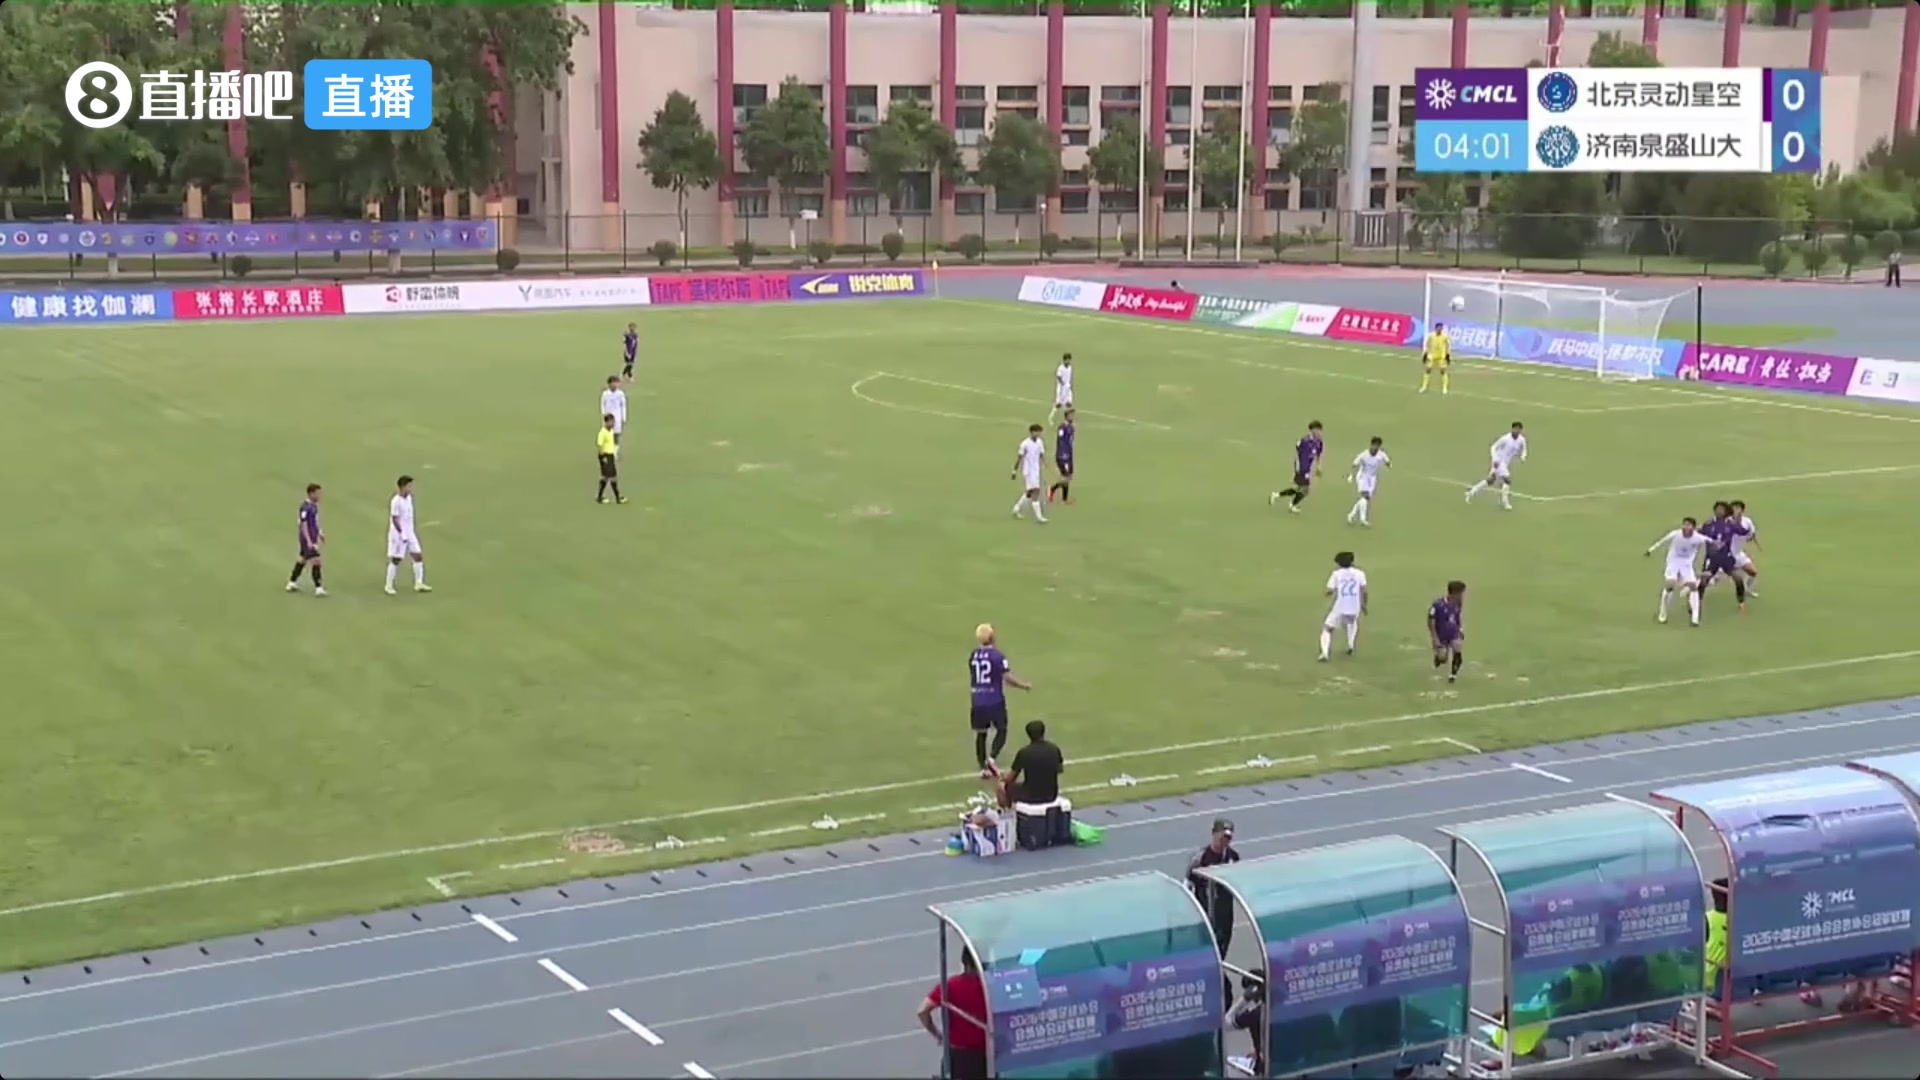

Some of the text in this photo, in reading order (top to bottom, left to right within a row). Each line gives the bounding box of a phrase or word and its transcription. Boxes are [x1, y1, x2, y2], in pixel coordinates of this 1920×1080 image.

[1700, 352, 1750, 374] CARE
[1340, 578, 1357, 597] 22
[971, 659, 991, 684] 12
